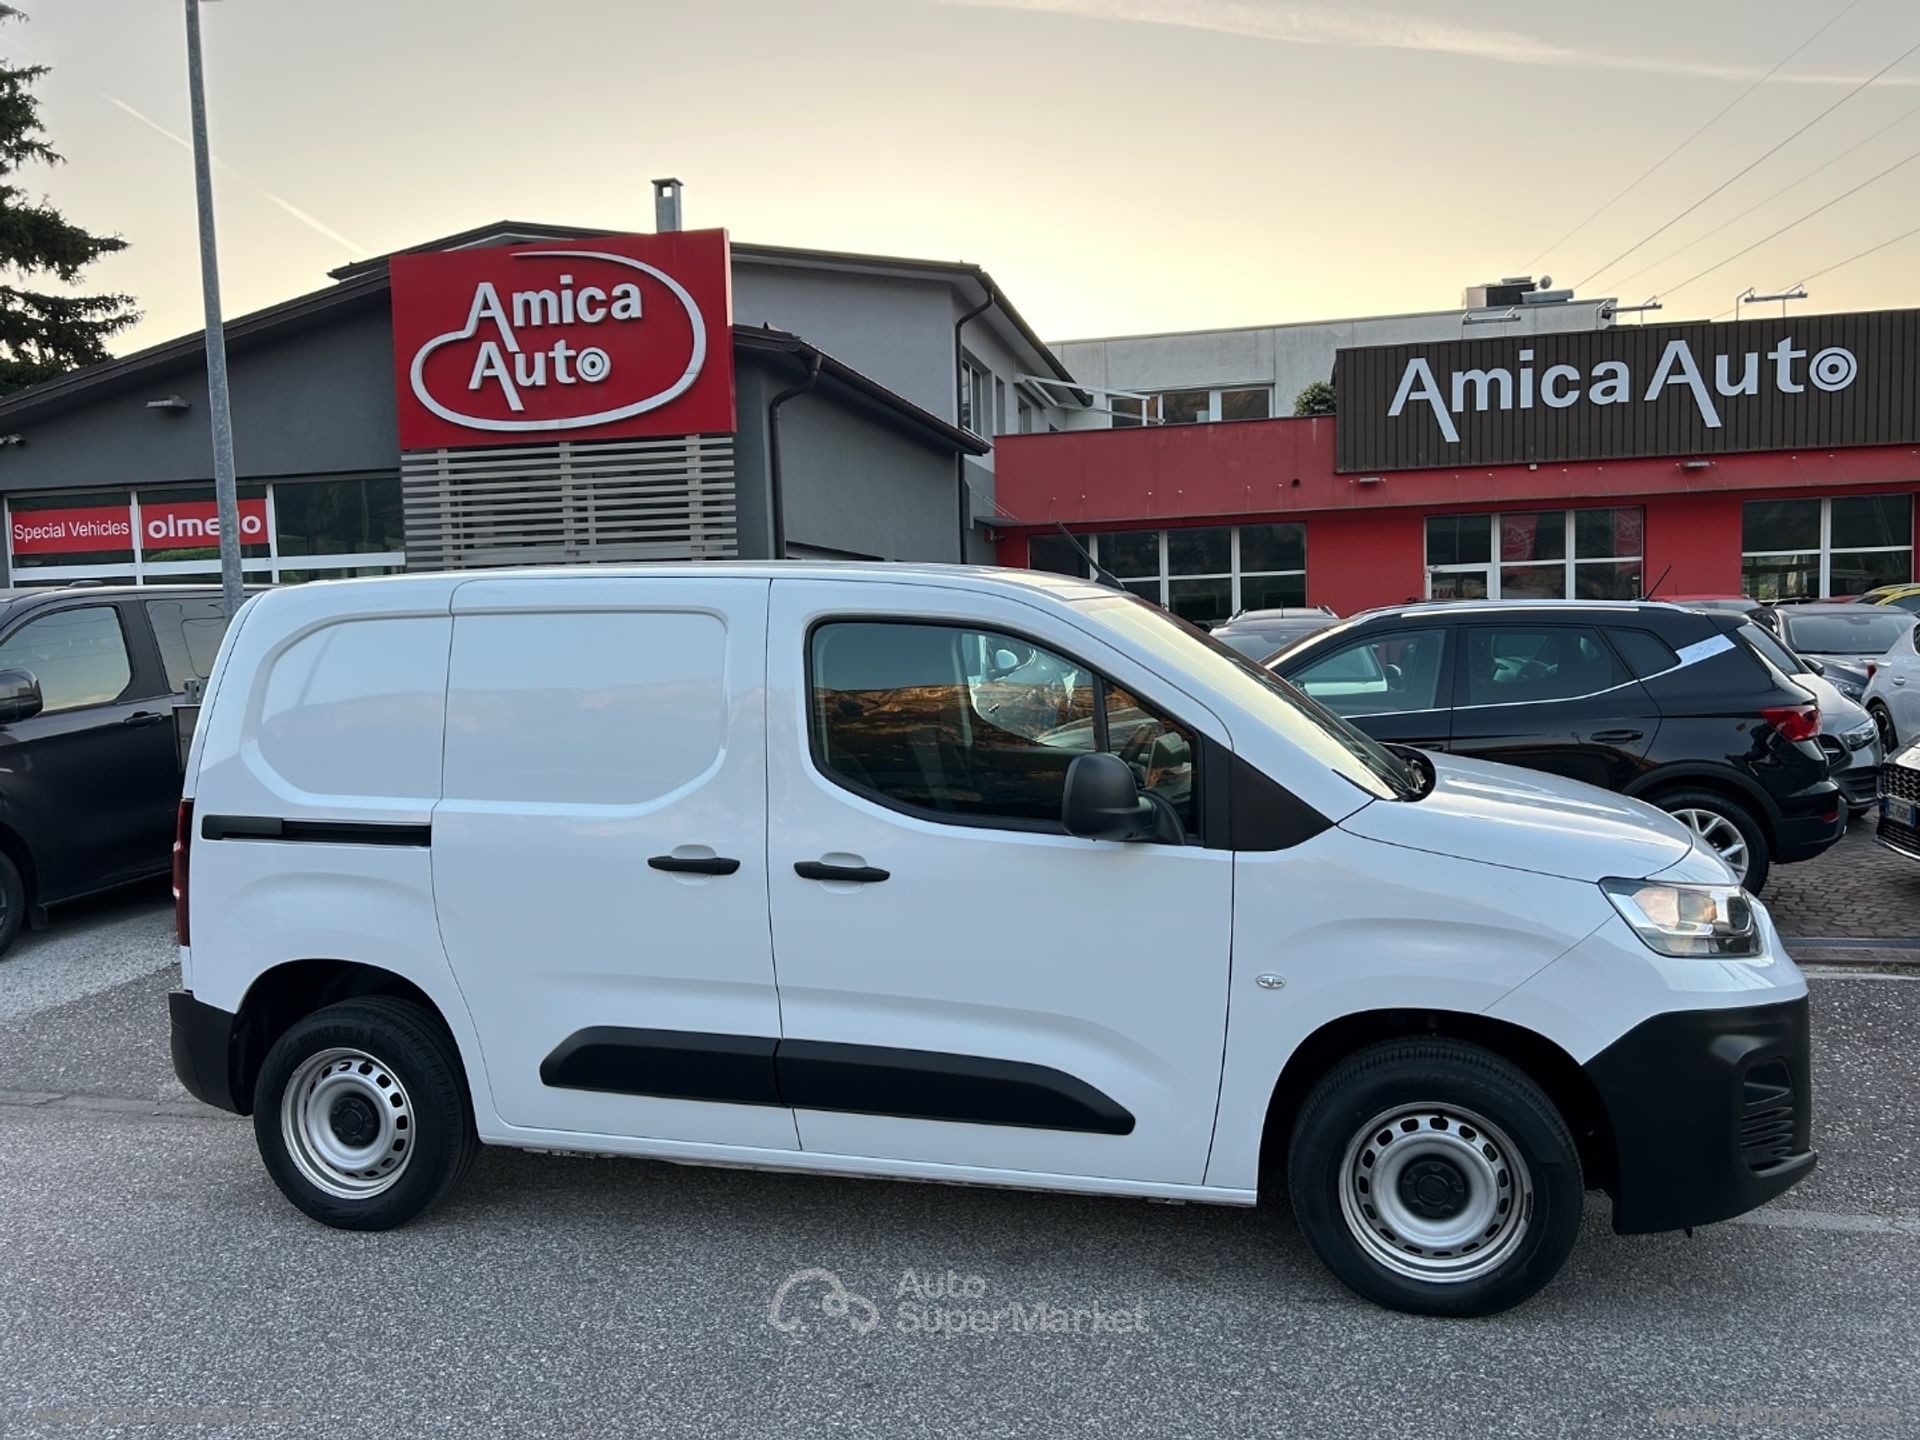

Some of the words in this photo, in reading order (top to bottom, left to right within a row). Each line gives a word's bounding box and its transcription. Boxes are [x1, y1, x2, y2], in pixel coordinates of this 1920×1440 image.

[464, 274, 643, 352] Amica
[468, 338, 611, 411] Auto
[1387, 349, 1630, 443] Amica
[1644, 336, 1858, 428] Auto
[14, 522, 65, 543] Special
[69, 520, 130, 537] Vehicles
[147, 513, 262, 539] olmeo
